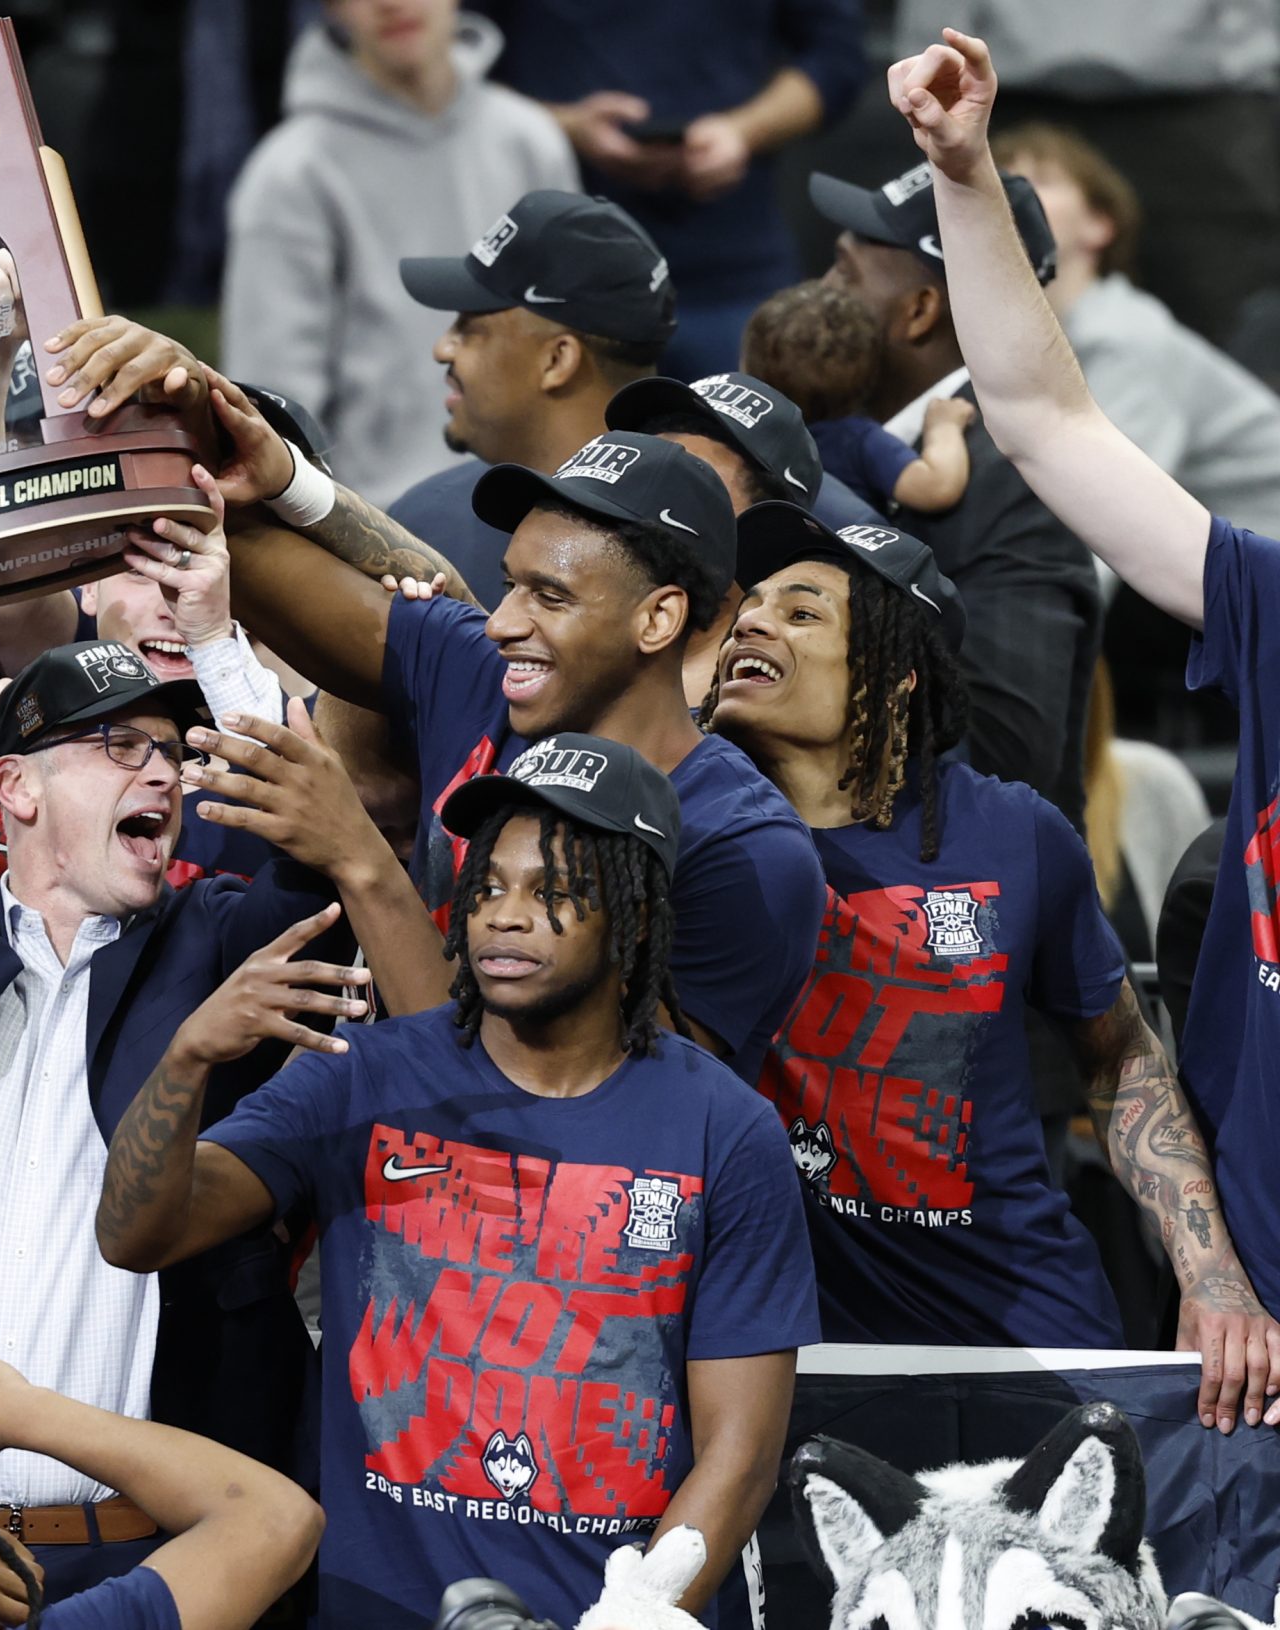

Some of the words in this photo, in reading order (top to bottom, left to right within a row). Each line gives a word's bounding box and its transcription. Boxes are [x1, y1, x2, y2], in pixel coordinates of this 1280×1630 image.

[13, 463, 117, 504] CHAMPION
[74, 644, 133, 667] FINAL
[21, 713, 40, 733] FOUR
[930, 901, 970, 917] FINAL
[936, 929, 975, 945] FOUR
[1183, 1179, 1212, 1195] GOD
[634, 1190, 674, 1210] FINAL
[880, 1205, 973, 1228] CHAMPS
[632, 1219, 670, 1239] FOUR
[412, 1486, 458, 1514] EAST
[466, 1499, 572, 1534] REGIONAL
